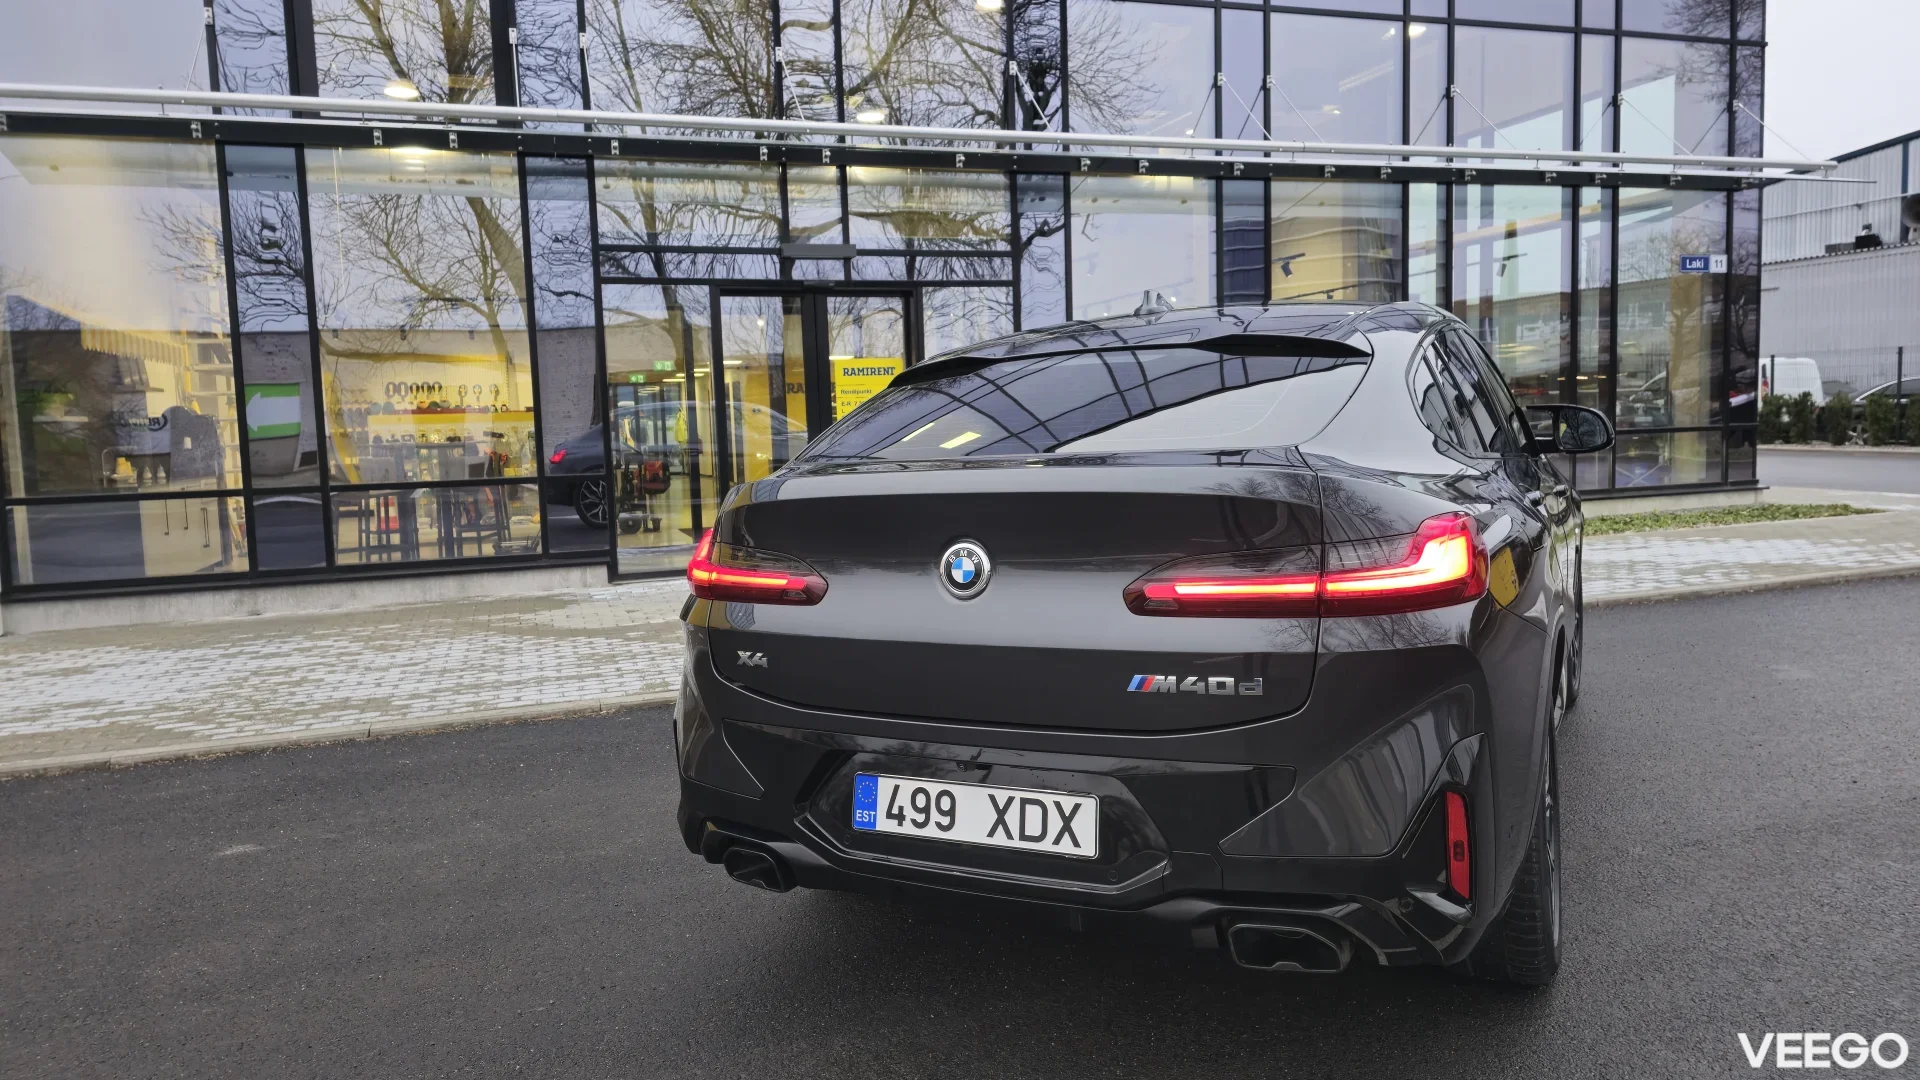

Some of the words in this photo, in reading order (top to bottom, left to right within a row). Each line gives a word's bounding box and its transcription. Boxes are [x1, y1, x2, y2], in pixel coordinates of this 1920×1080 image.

[1686, 258, 1704, 268] Laki
[1714, 259, 1723, 268] 11
[842, 366, 896, 377] RAMIRENT
[786, 382, 805, 394] RA
[948, 549, 980, 564] BMW
[736, 650, 769, 668] X4
[1148, 675, 1263, 696] M40d
[856, 809, 876, 823] EST
[885, 784, 957, 832] 499
[986, 793, 1082, 848] XDX
